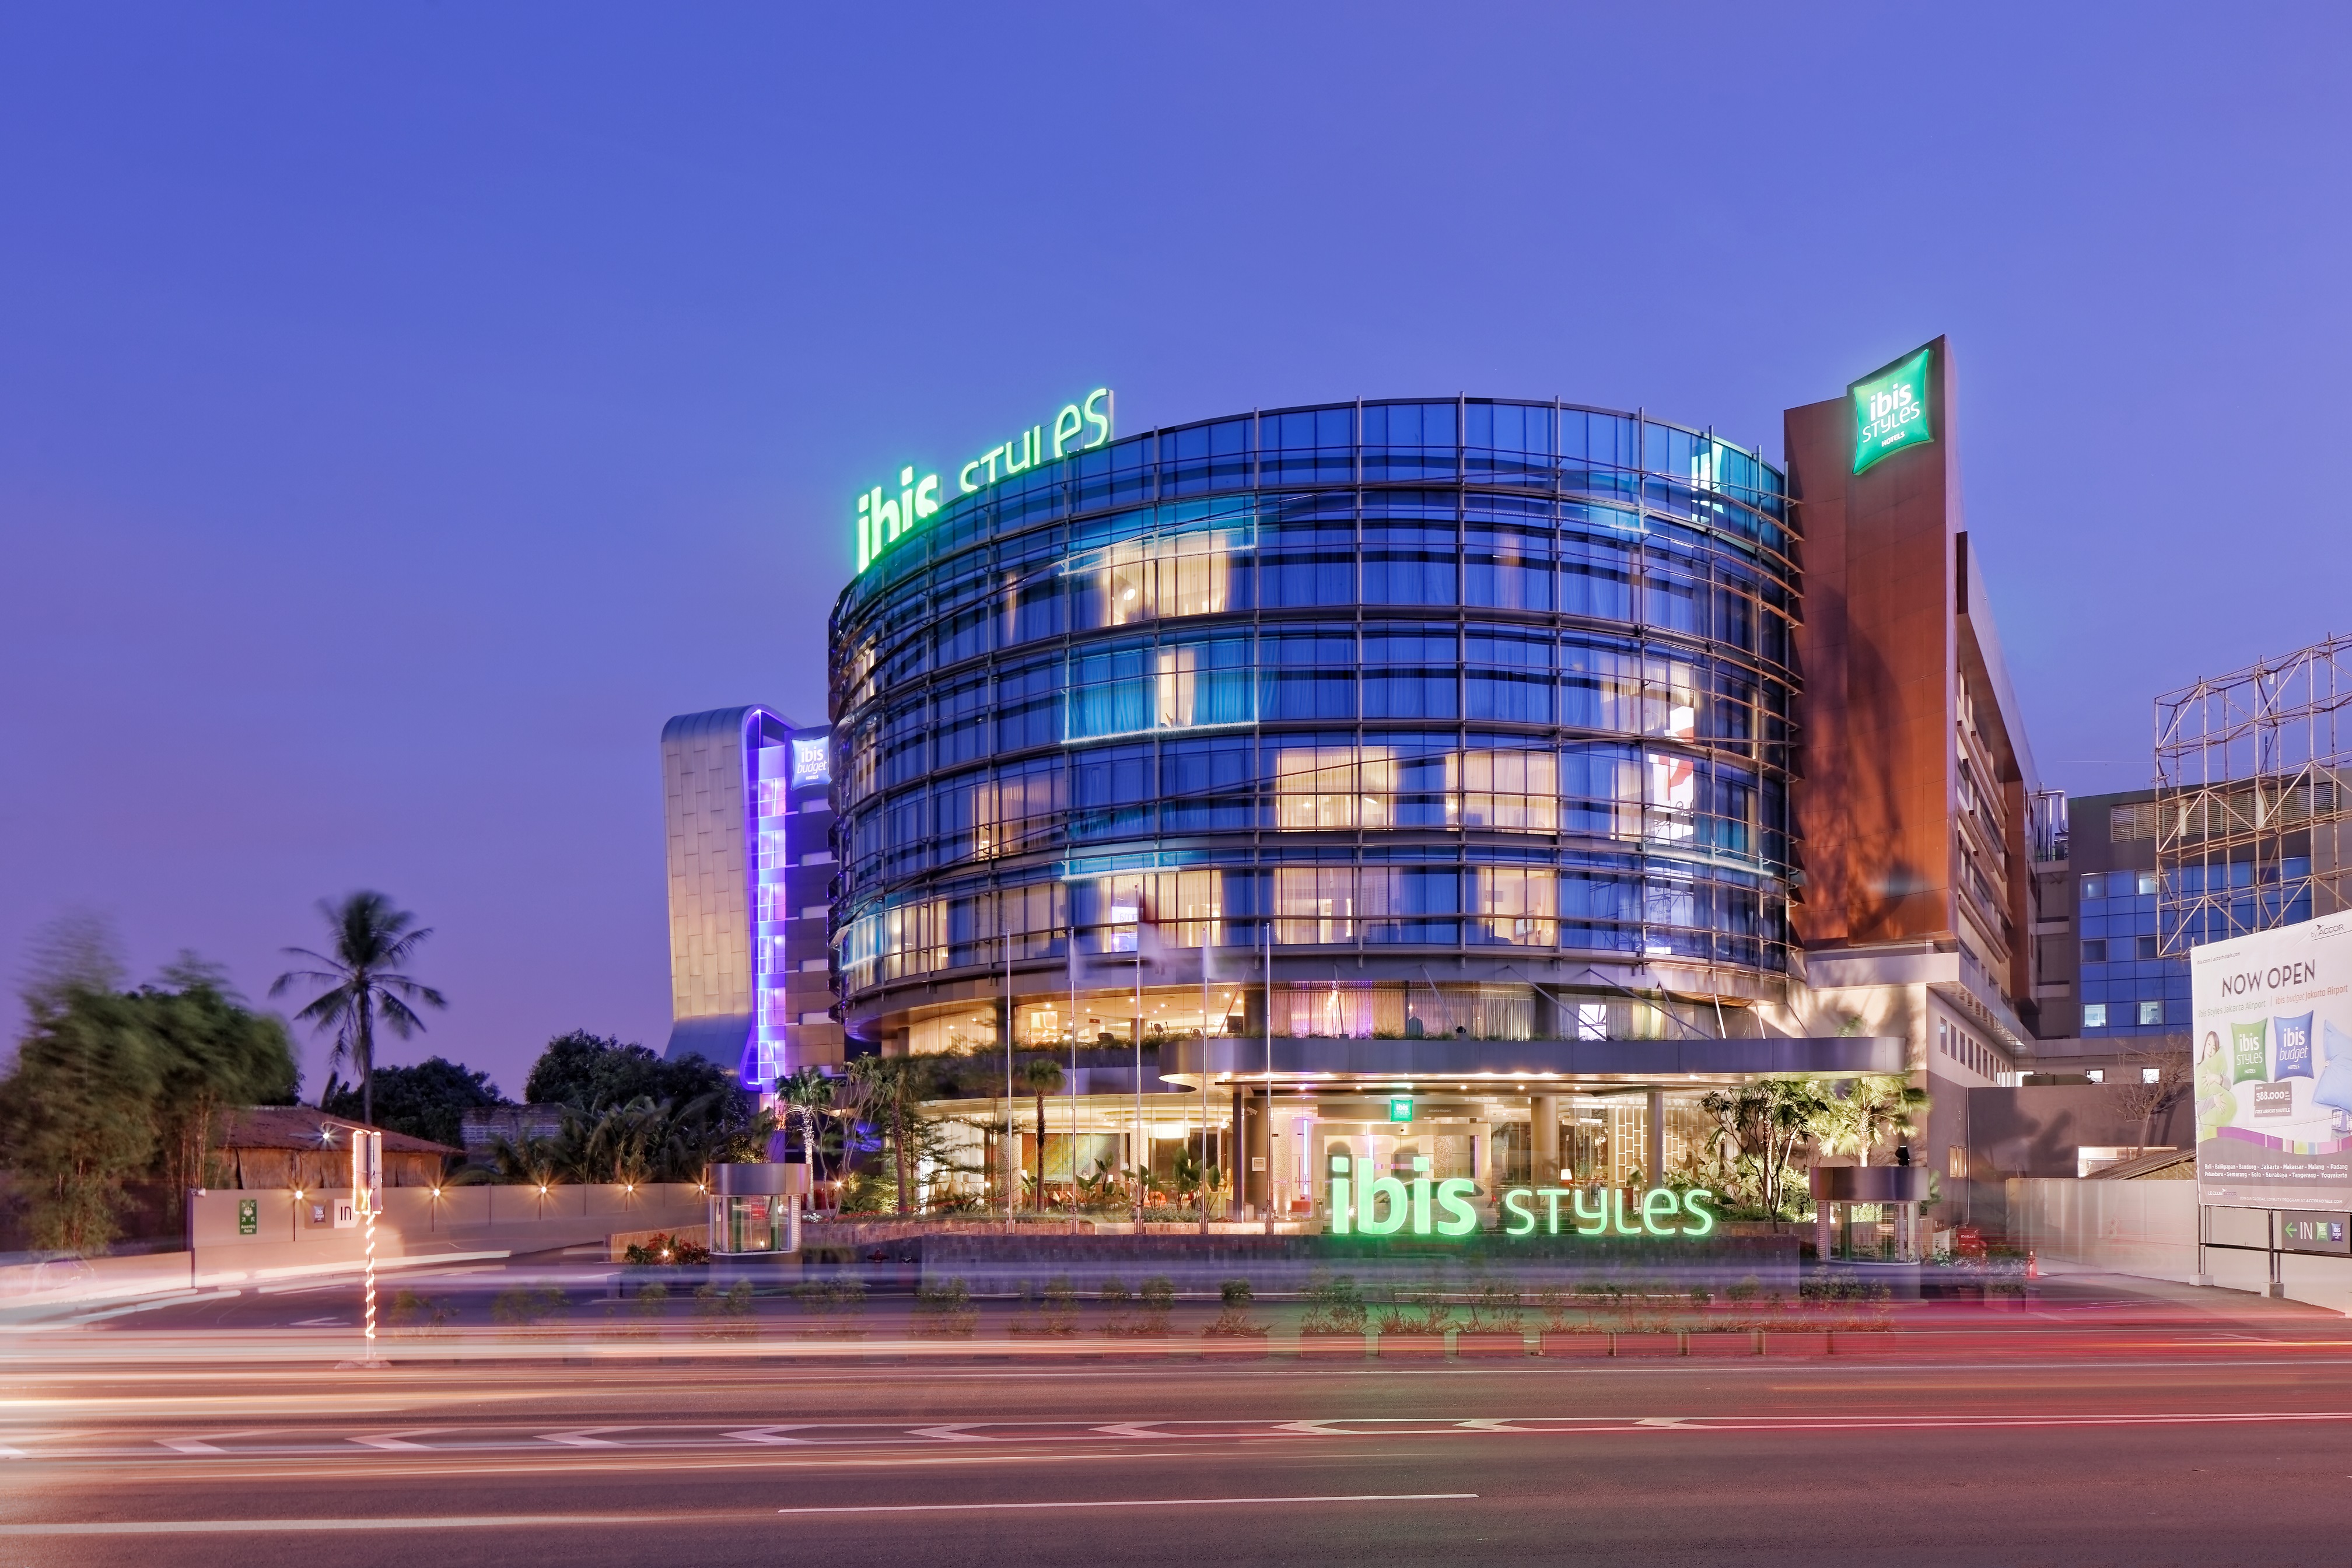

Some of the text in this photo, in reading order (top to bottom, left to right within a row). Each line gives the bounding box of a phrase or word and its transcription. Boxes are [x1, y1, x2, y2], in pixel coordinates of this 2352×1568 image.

[1870, 383, 1912, 421] ibis
[1881, 431, 1905, 447] HOTELS
[801, 746, 824, 762] ibis
[797, 760, 827, 774] budget
[2318, 924, 2344, 936] ACCOR
[2213, 952, 2241, 961] accorhotels.com
[2222, 959, 2315, 997] NOW OPEN
[2276, 985, 2348, 1005] ibis budget Jakarta Airport
[2207, 1007, 2222, 1017] Styles
[2224, 1005, 2244, 1014] Jakarta
[2245, 1000, 2266, 1010] Airport
[2239, 1032, 2260, 1052] ibis
[2283, 1027, 2305, 1048] ibis
[2279, 1045, 2309, 1063] budget
[2256, 1091, 2285, 1102] 388.000
[1332, 1157, 1476, 1235] ibis
[2300, 1222, 2313, 1240] IN
